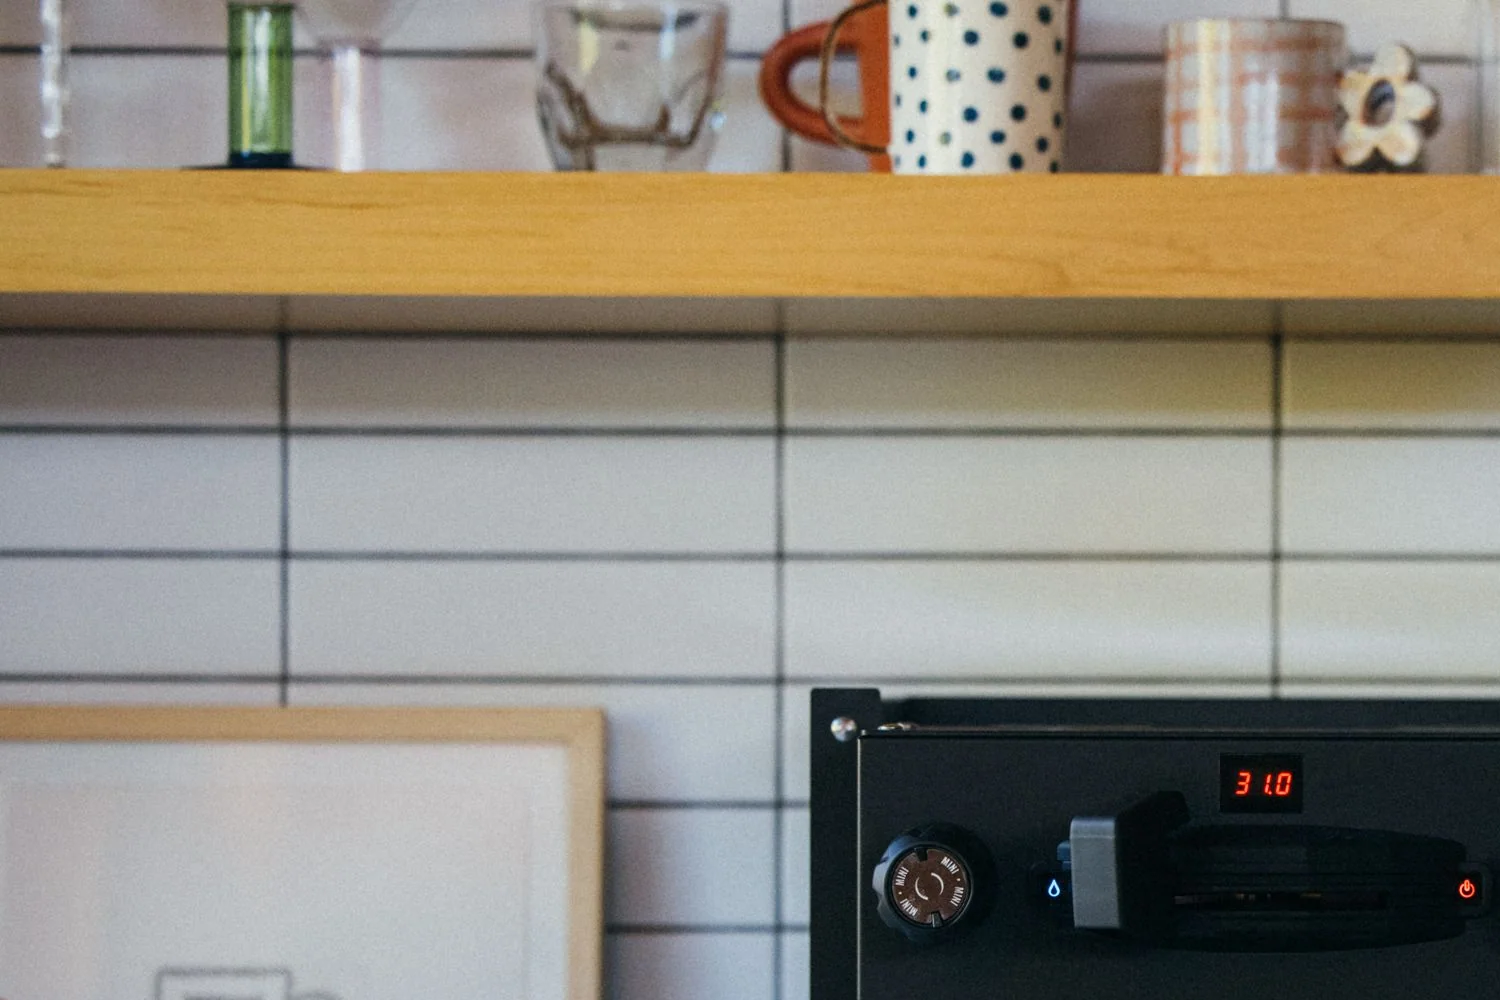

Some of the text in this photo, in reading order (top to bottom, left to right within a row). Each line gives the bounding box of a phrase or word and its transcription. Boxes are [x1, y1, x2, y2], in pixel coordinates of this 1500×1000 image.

[895, 866, 919, 917] MINI MINI
[941, 857, 964, 907] MINI MINI
